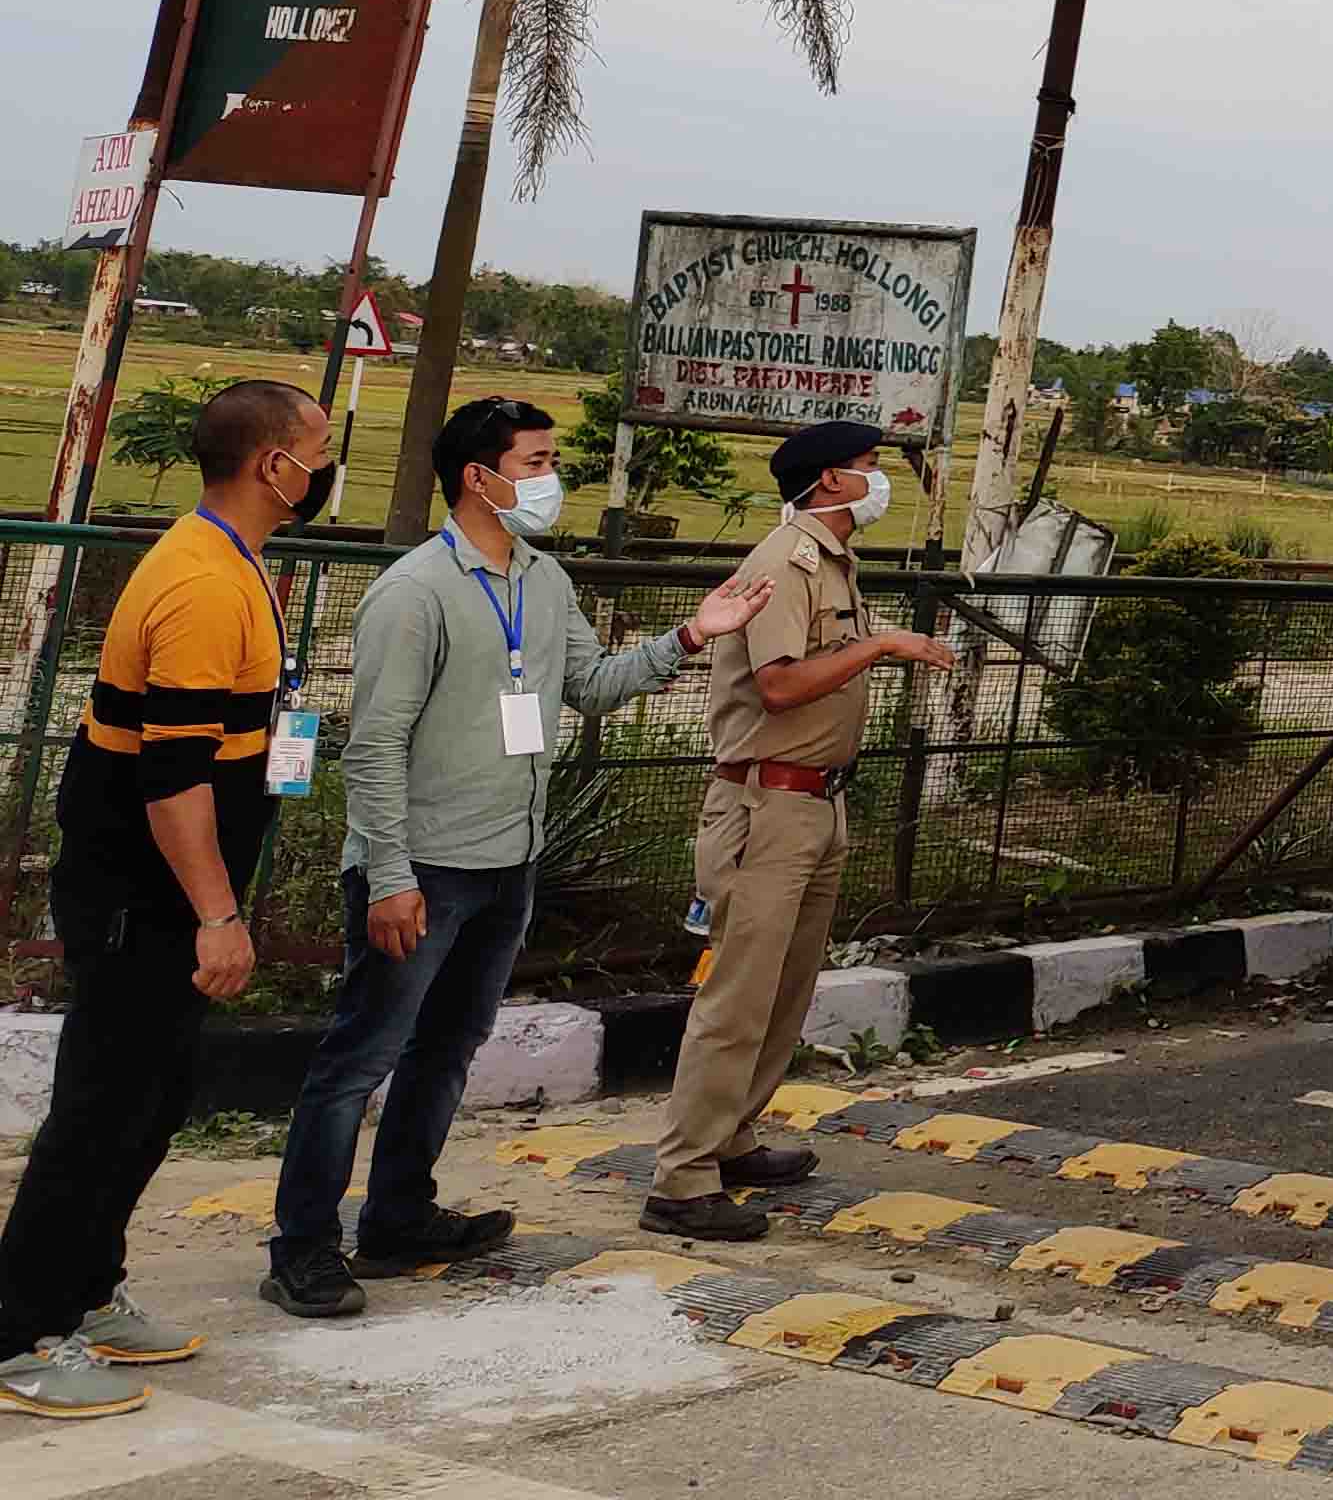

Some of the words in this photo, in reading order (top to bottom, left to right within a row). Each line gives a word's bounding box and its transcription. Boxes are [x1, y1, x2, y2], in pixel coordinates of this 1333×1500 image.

[92, 135, 137, 172] ATM
[71, 186, 135, 225] AHEAD
[647, 244, 736, 322] BAPTIST
[836, 240, 947, 333] HOLLONGI
